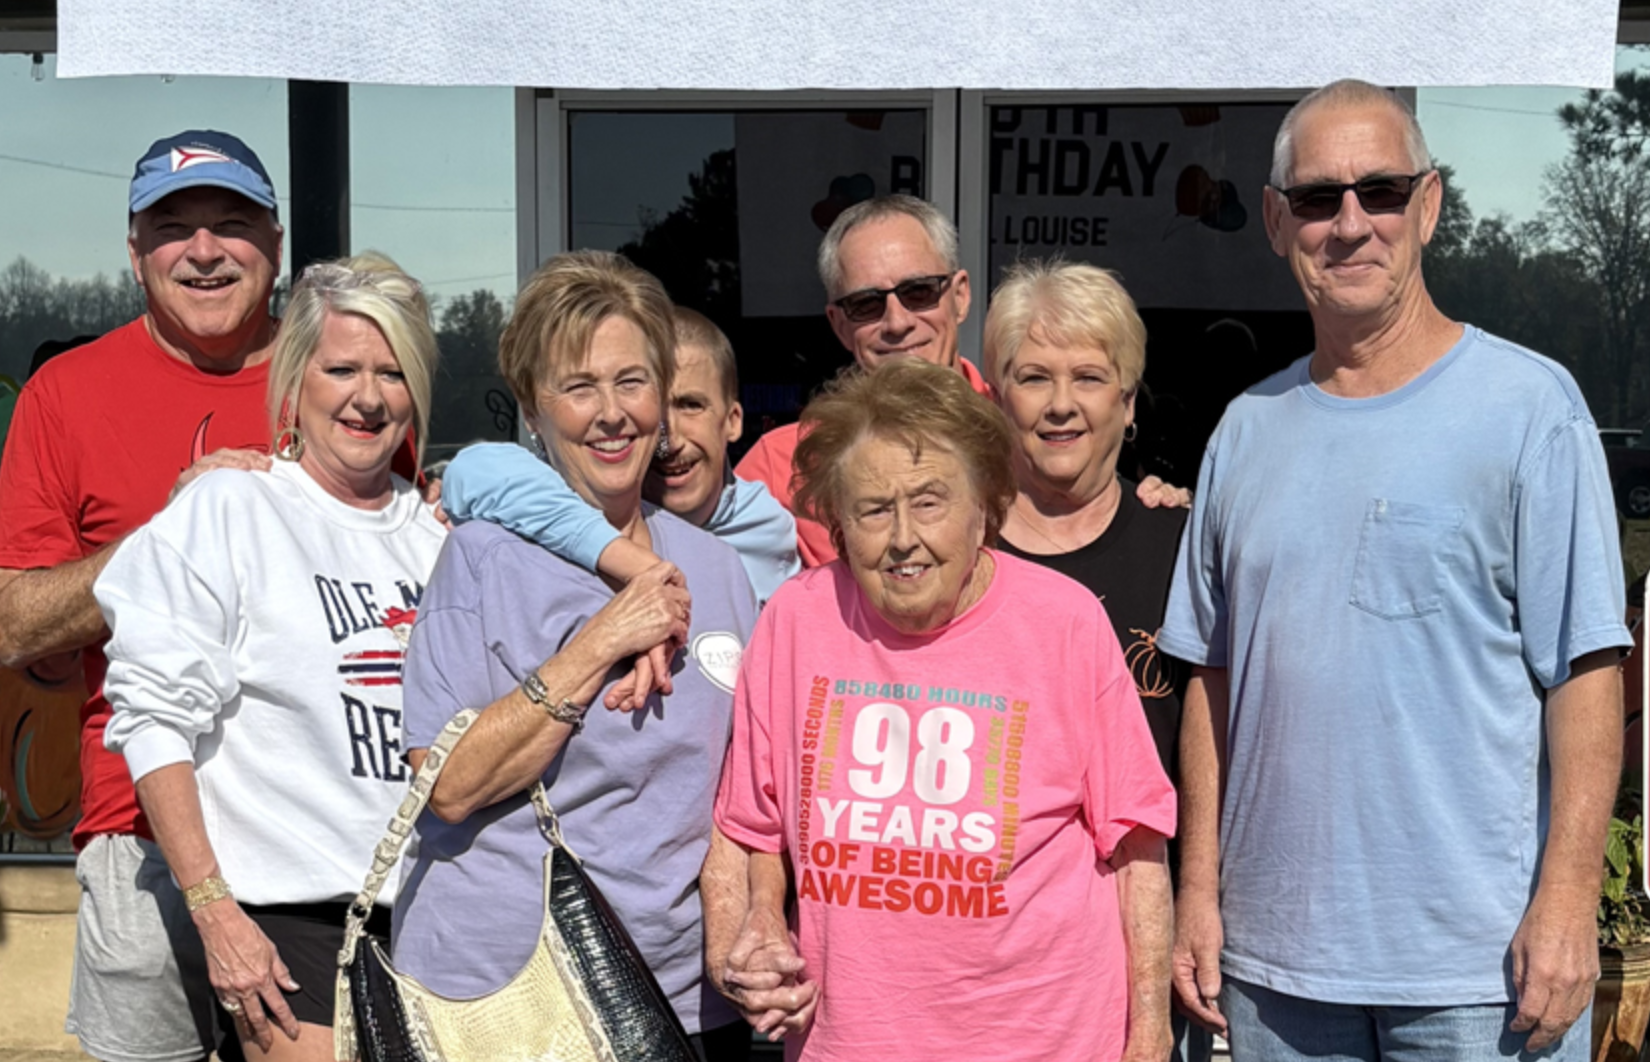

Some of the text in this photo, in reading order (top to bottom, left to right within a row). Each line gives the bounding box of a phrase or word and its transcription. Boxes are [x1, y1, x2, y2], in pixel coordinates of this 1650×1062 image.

[1004, 216, 1109, 246] LOUISE
[314, 573, 384, 644] OLE
[834, 679, 1007, 712] 858480 HOURS
[799, 675, 830, 865] 3090528000 SECONDS
[817, 760, 835, 791] 1176
[848, 702, 975, 805] 98
[1003, 700, 1029, 798] 51508800
[816, 797, 996, 852] YEARS
[811, 840, 994, 885] OF BEING
[800, 868, 1010, 919] AWESOME
